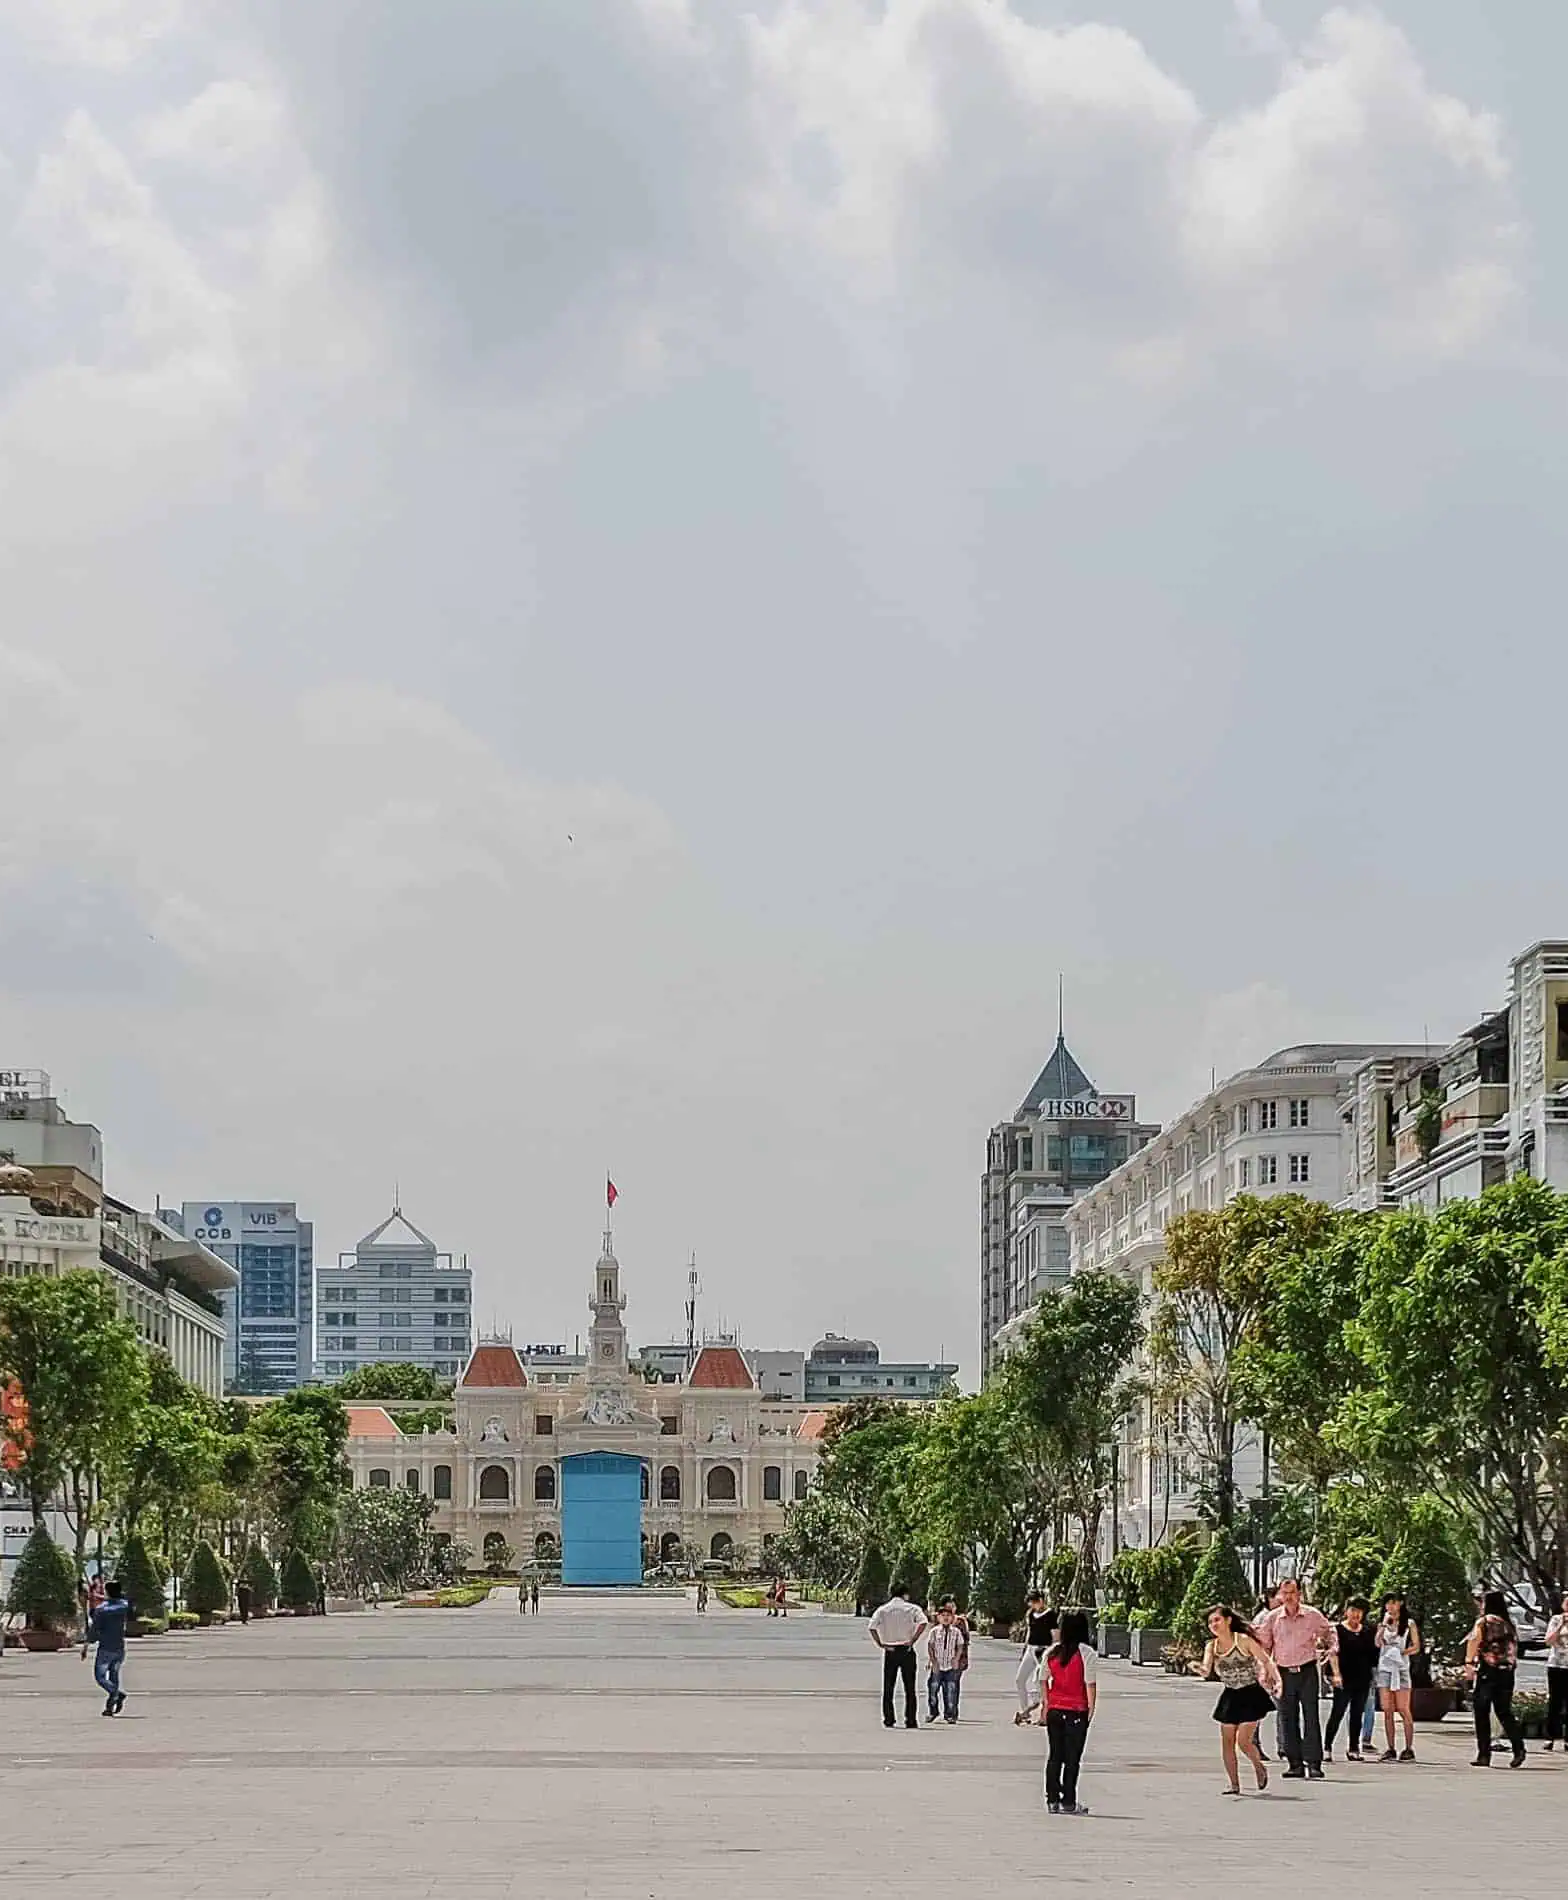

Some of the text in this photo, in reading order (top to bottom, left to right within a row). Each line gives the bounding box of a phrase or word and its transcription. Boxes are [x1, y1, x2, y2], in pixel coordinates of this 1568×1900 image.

[1049, 1101, 1098, 1115] HSBC
[250, 1212, 278, 1225] VIB
[14, 1218, 91, 1242] HOTEL
